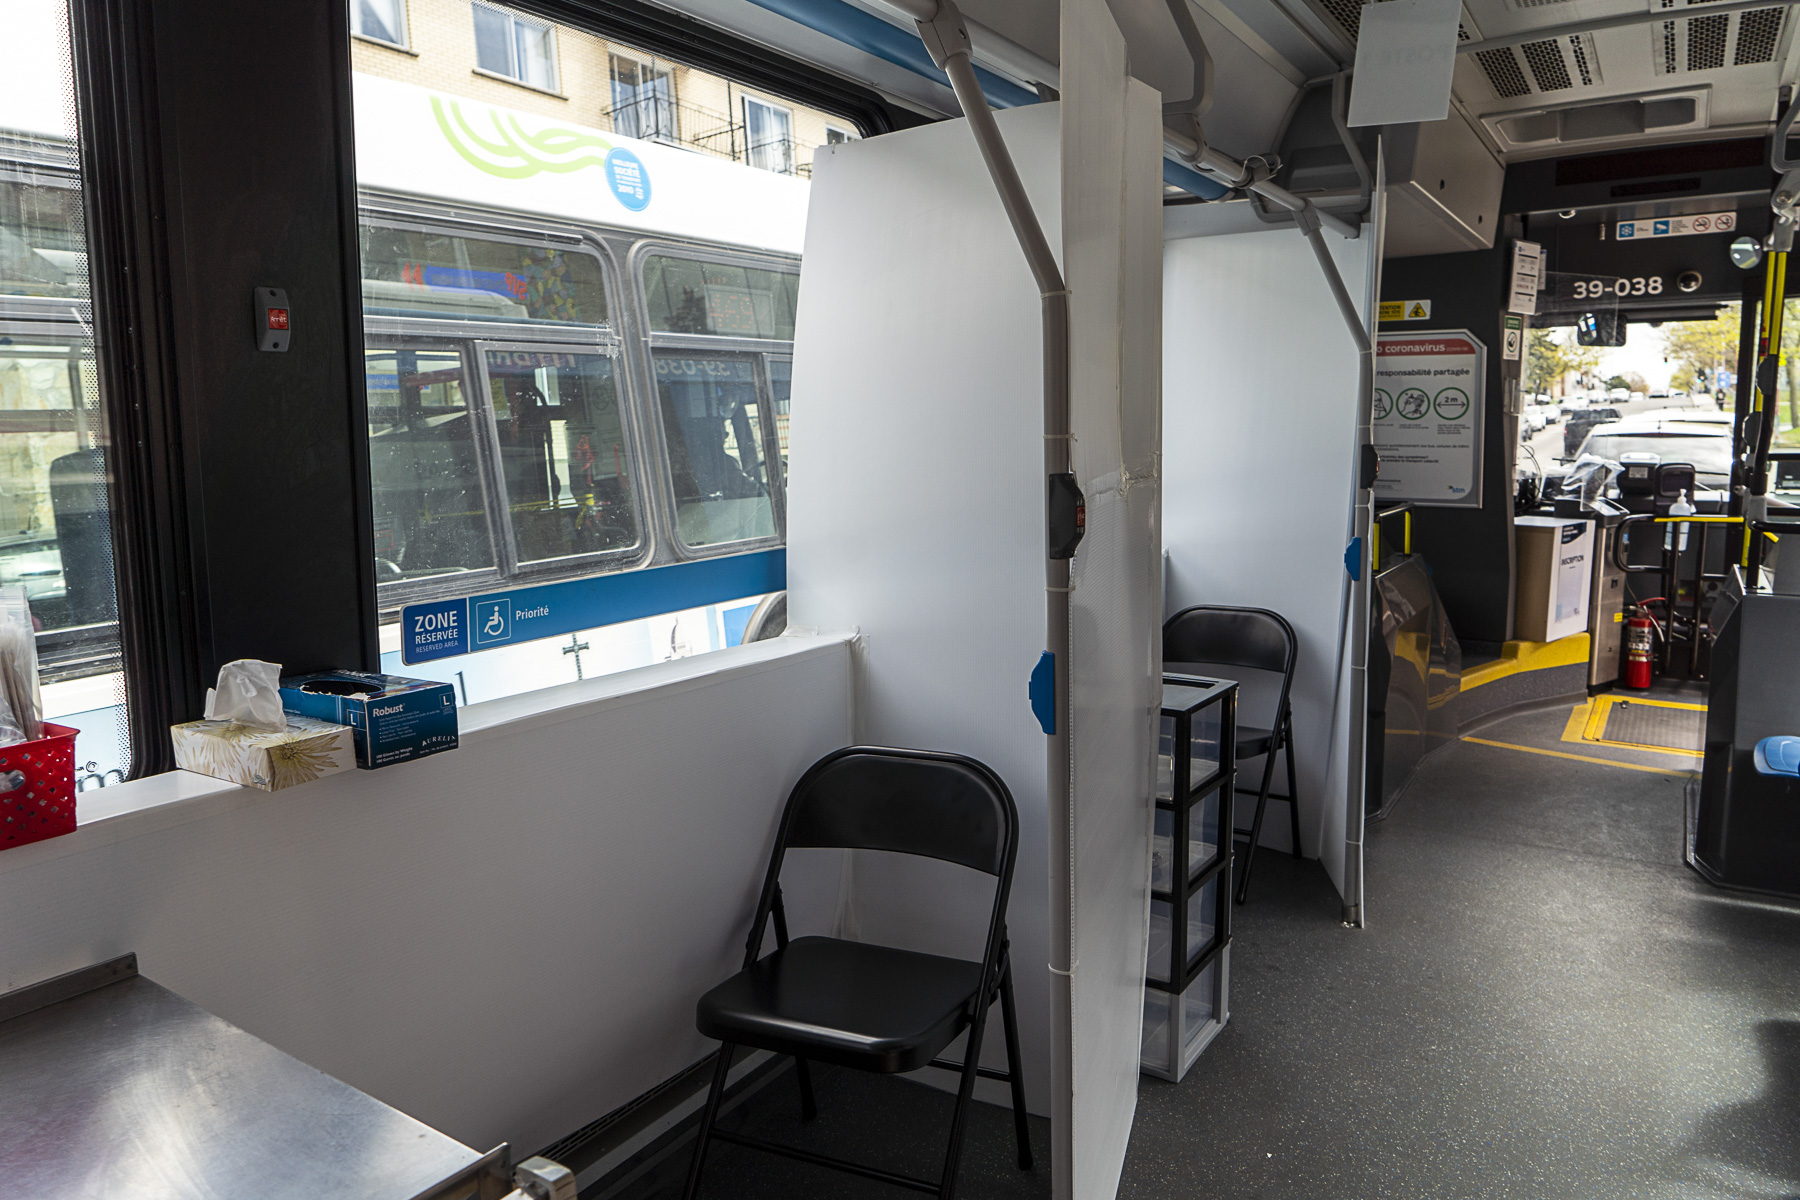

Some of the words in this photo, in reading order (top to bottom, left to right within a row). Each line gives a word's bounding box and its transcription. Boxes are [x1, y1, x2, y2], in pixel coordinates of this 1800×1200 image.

[1572, 276, 1663, 299] 39-038
[270, 315, 287, 323] Arrêt
[1385, 343, 1446, 353] coronavirus
[1376, 368, 1432, 378] responsabilité
[1433, 368, 1470, 378] partagée
[515, 605, 549, 621] Priorité
[414, 610, 458, 633] ZONE
[415, 628, 459, 645] RÉSERVÉE
[416, 643, 444, 654] RESERVED
[444, 640, 459, 649] AREA
[443, 695, 450, 706] L
[372, 703, 404, 718] Robust
[350, 713, 357, 726] L
[421, 735, 456, 747] AURELIA
